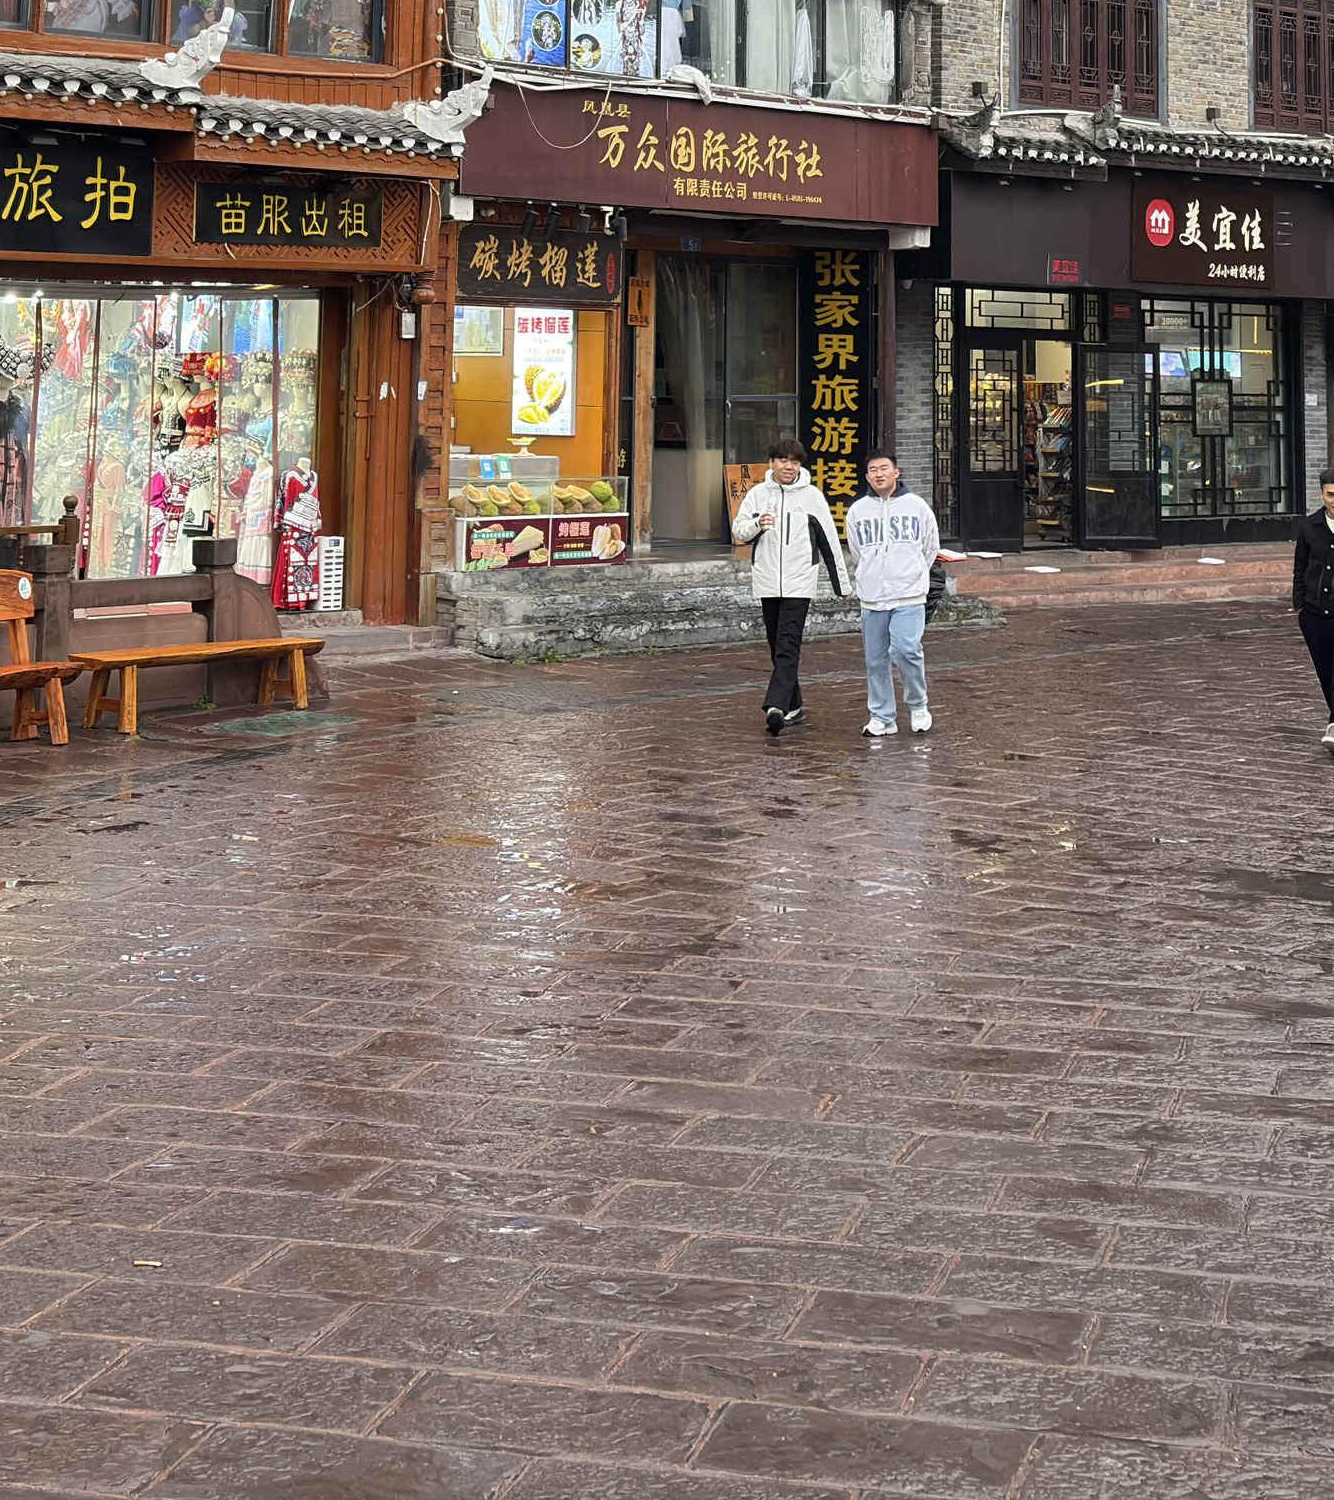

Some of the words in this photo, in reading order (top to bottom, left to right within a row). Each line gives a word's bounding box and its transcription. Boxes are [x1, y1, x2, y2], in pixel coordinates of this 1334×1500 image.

[581, 100, 630, 118] 凤凰县
[597, 121, 823, 184] 万众国际旅行社
[673, 177, 747, 200] 有限责任公司
[215, 192, 368, 239] 苗服出租
[1179, 199, 1265, 252] 美宜佳
[1208, 263, 1265, 281] 24小时便利店
[517, 317, 570, 333] 碳烤榴莲
